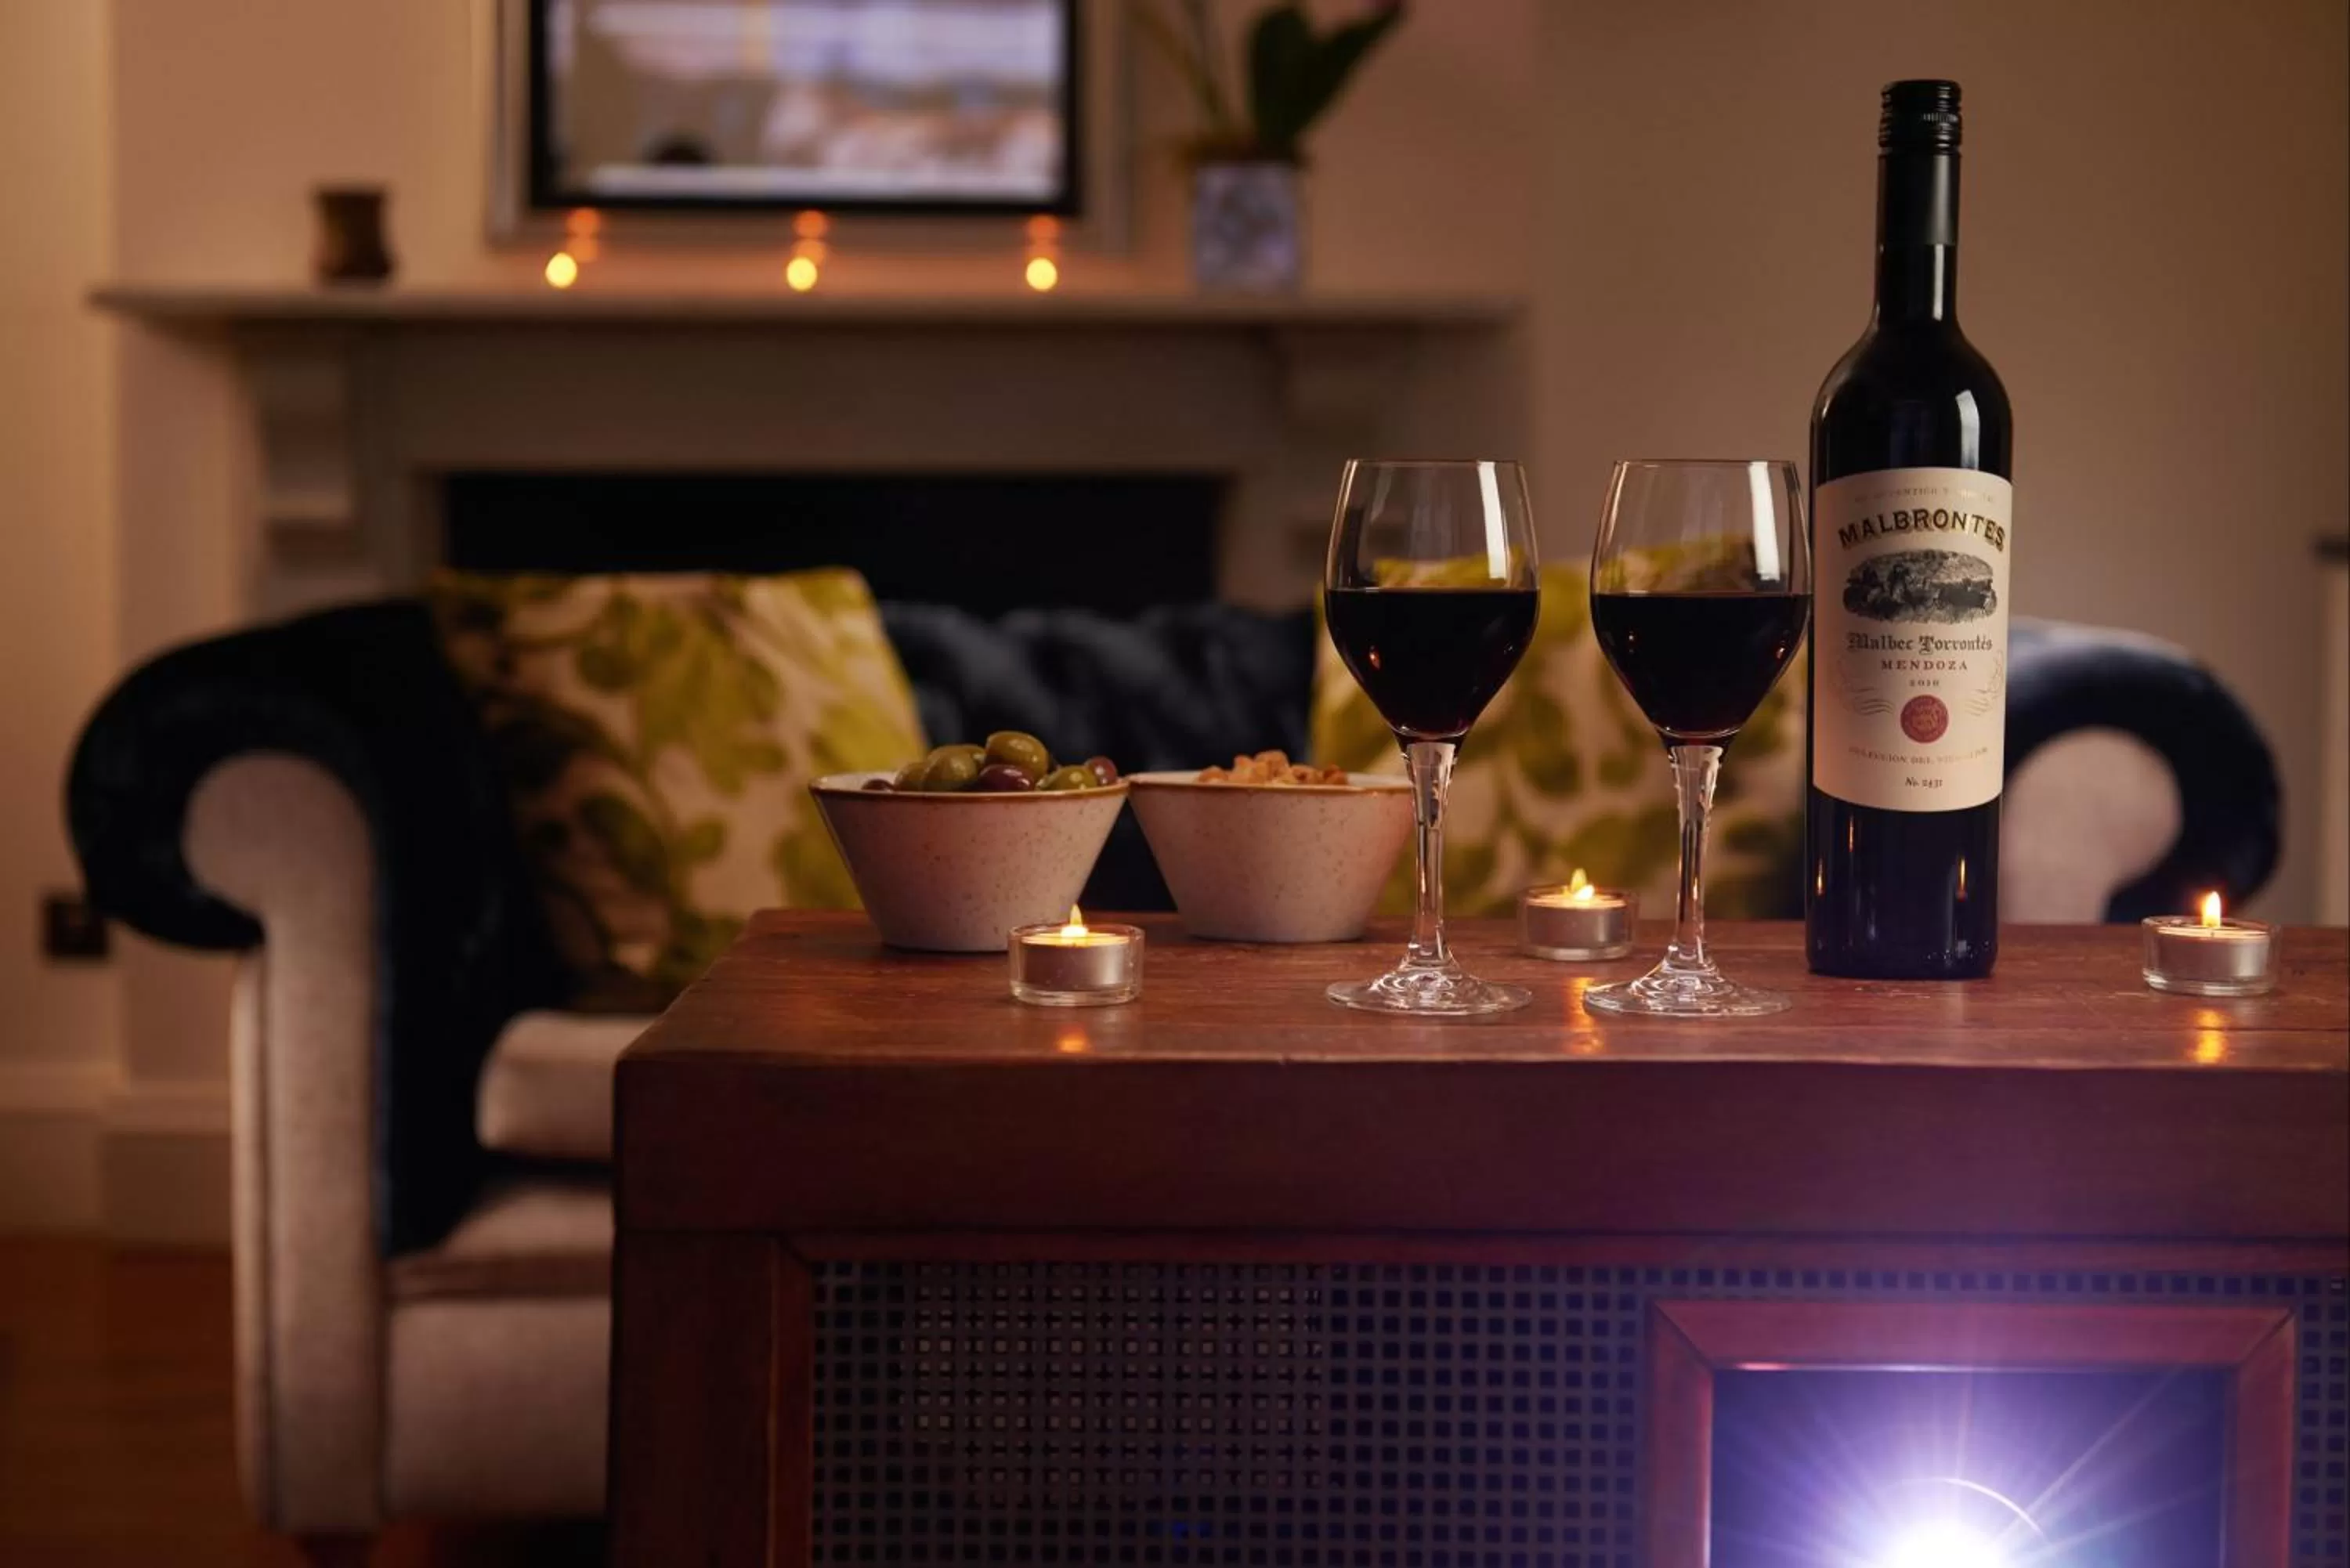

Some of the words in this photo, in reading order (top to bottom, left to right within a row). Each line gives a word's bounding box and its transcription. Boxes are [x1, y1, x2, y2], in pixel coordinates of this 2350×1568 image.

[1838, 508, 2006, 551] MALBRONTES
[1847, 632, 1914, 652] Malbec
[1881, 659, 1969, 671] MENDOZA
